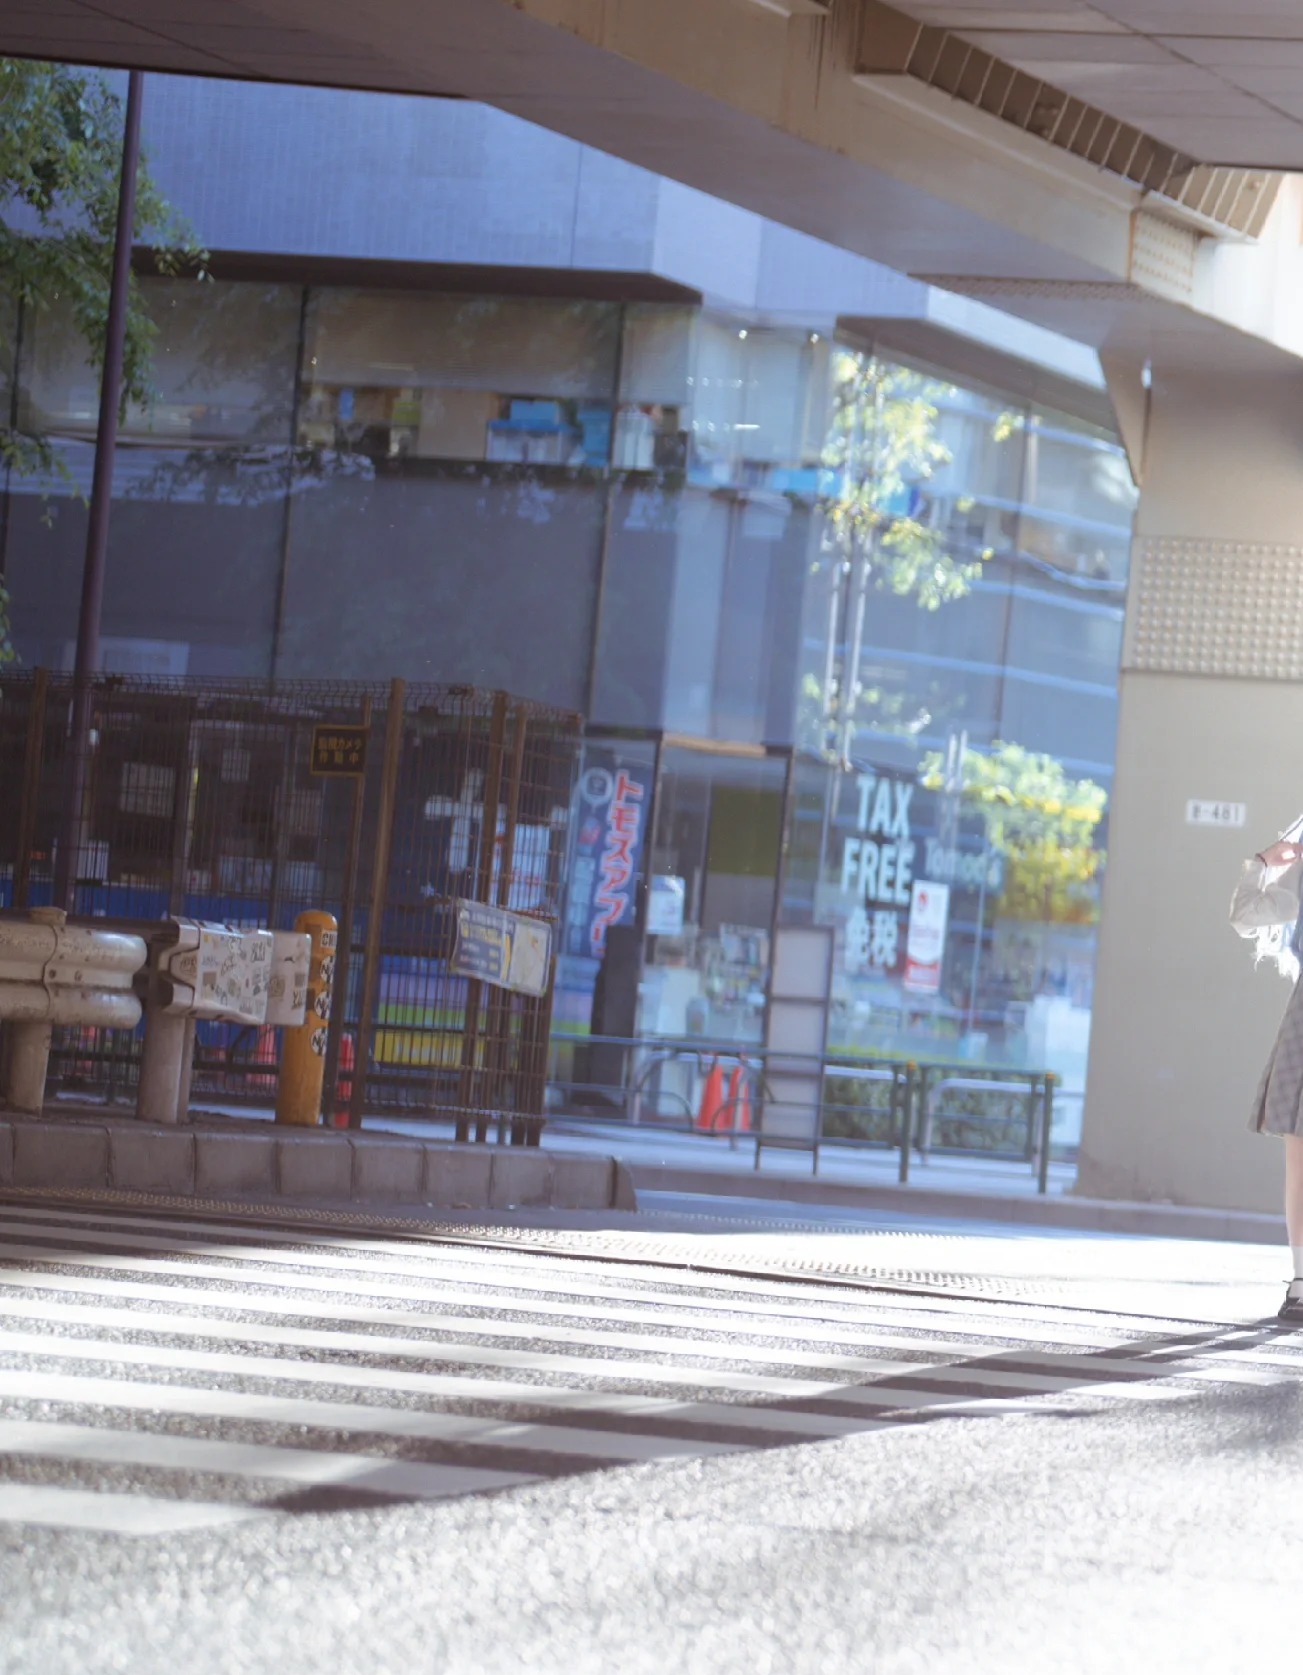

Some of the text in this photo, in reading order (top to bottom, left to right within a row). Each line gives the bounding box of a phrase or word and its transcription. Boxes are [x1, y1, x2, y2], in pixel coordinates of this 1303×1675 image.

[856, 773, 914, 838] TAX
[841, 833, 916, 906] FREE
[845, 908, 898, 973] 免税
